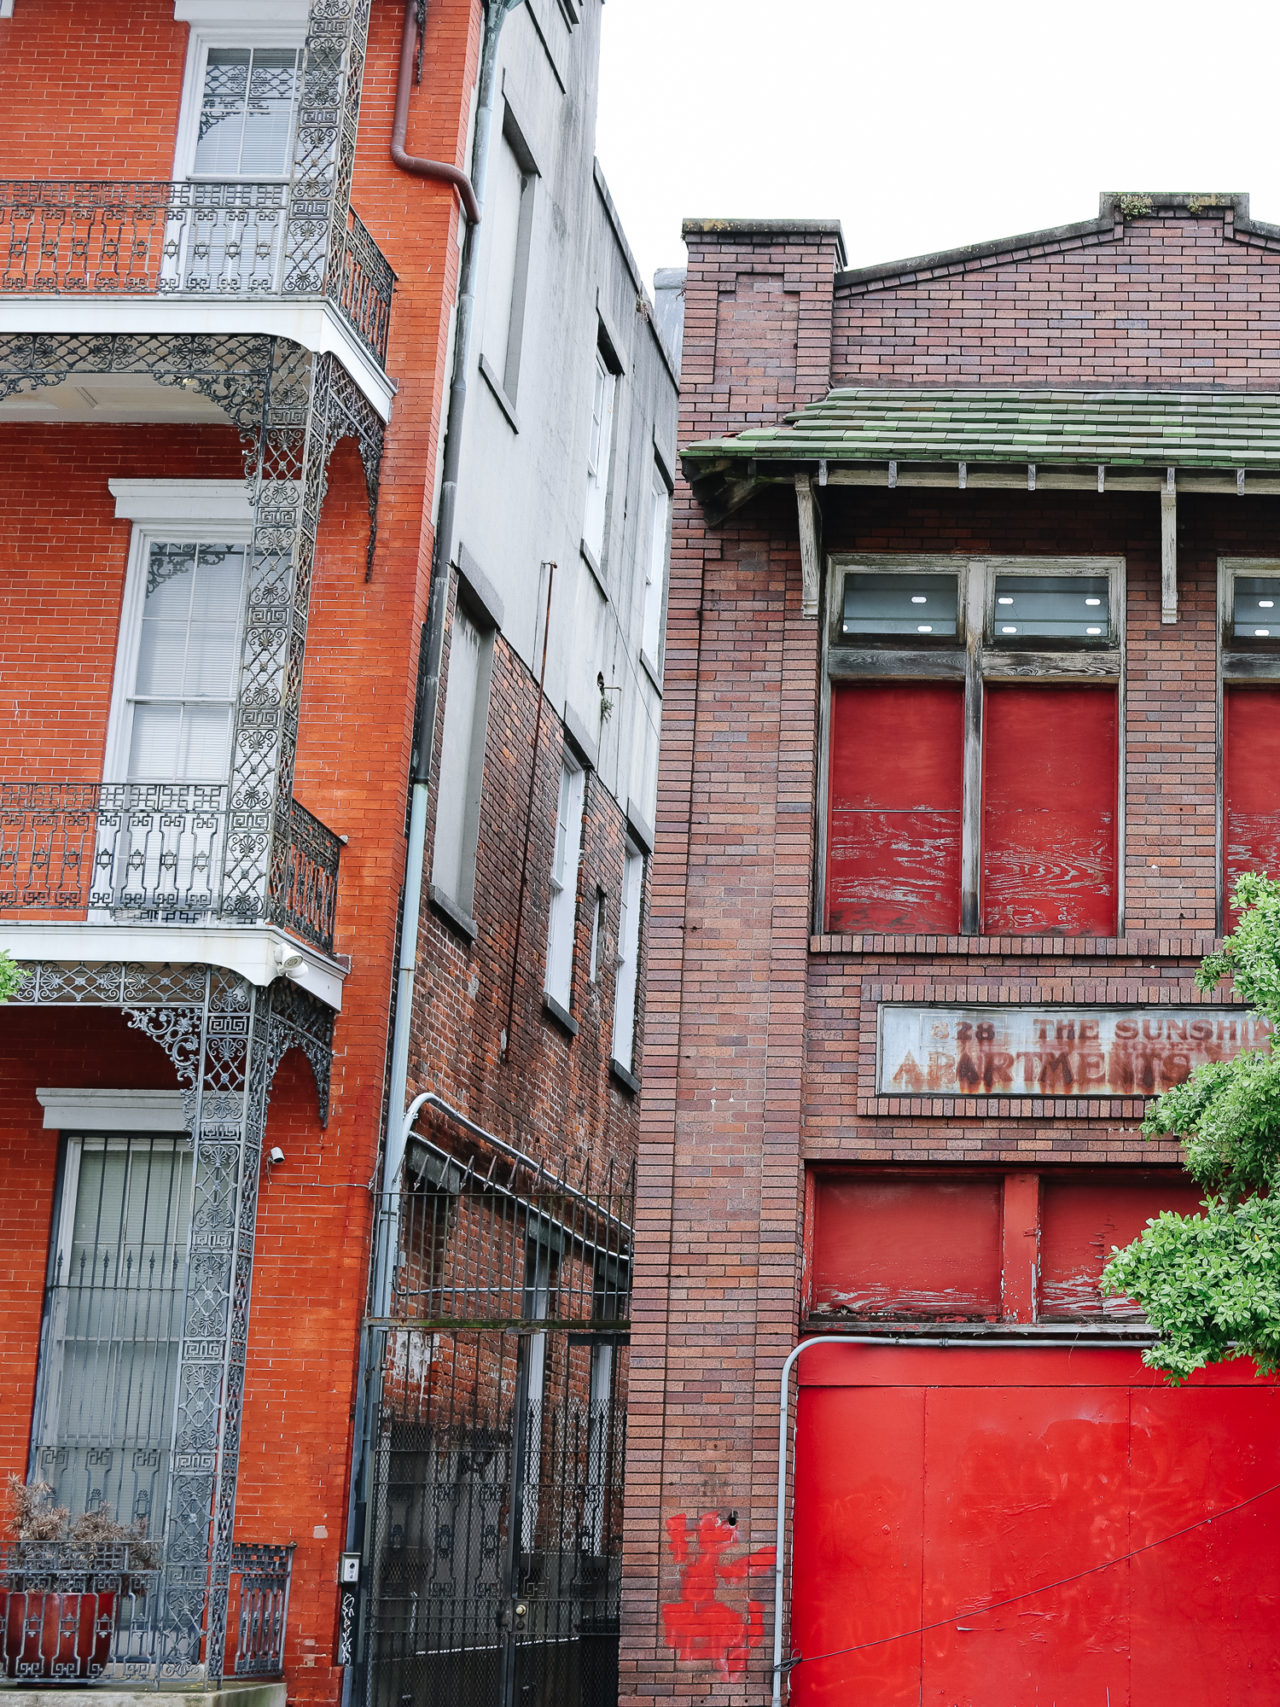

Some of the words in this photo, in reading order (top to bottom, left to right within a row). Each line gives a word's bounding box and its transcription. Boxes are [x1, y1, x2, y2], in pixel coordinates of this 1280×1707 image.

[932, 1021, 995, 1041] 828
[1033, 1018, 1100, 1040] THE
[1115, 1018, 1276, 1041] SUNSHIN
